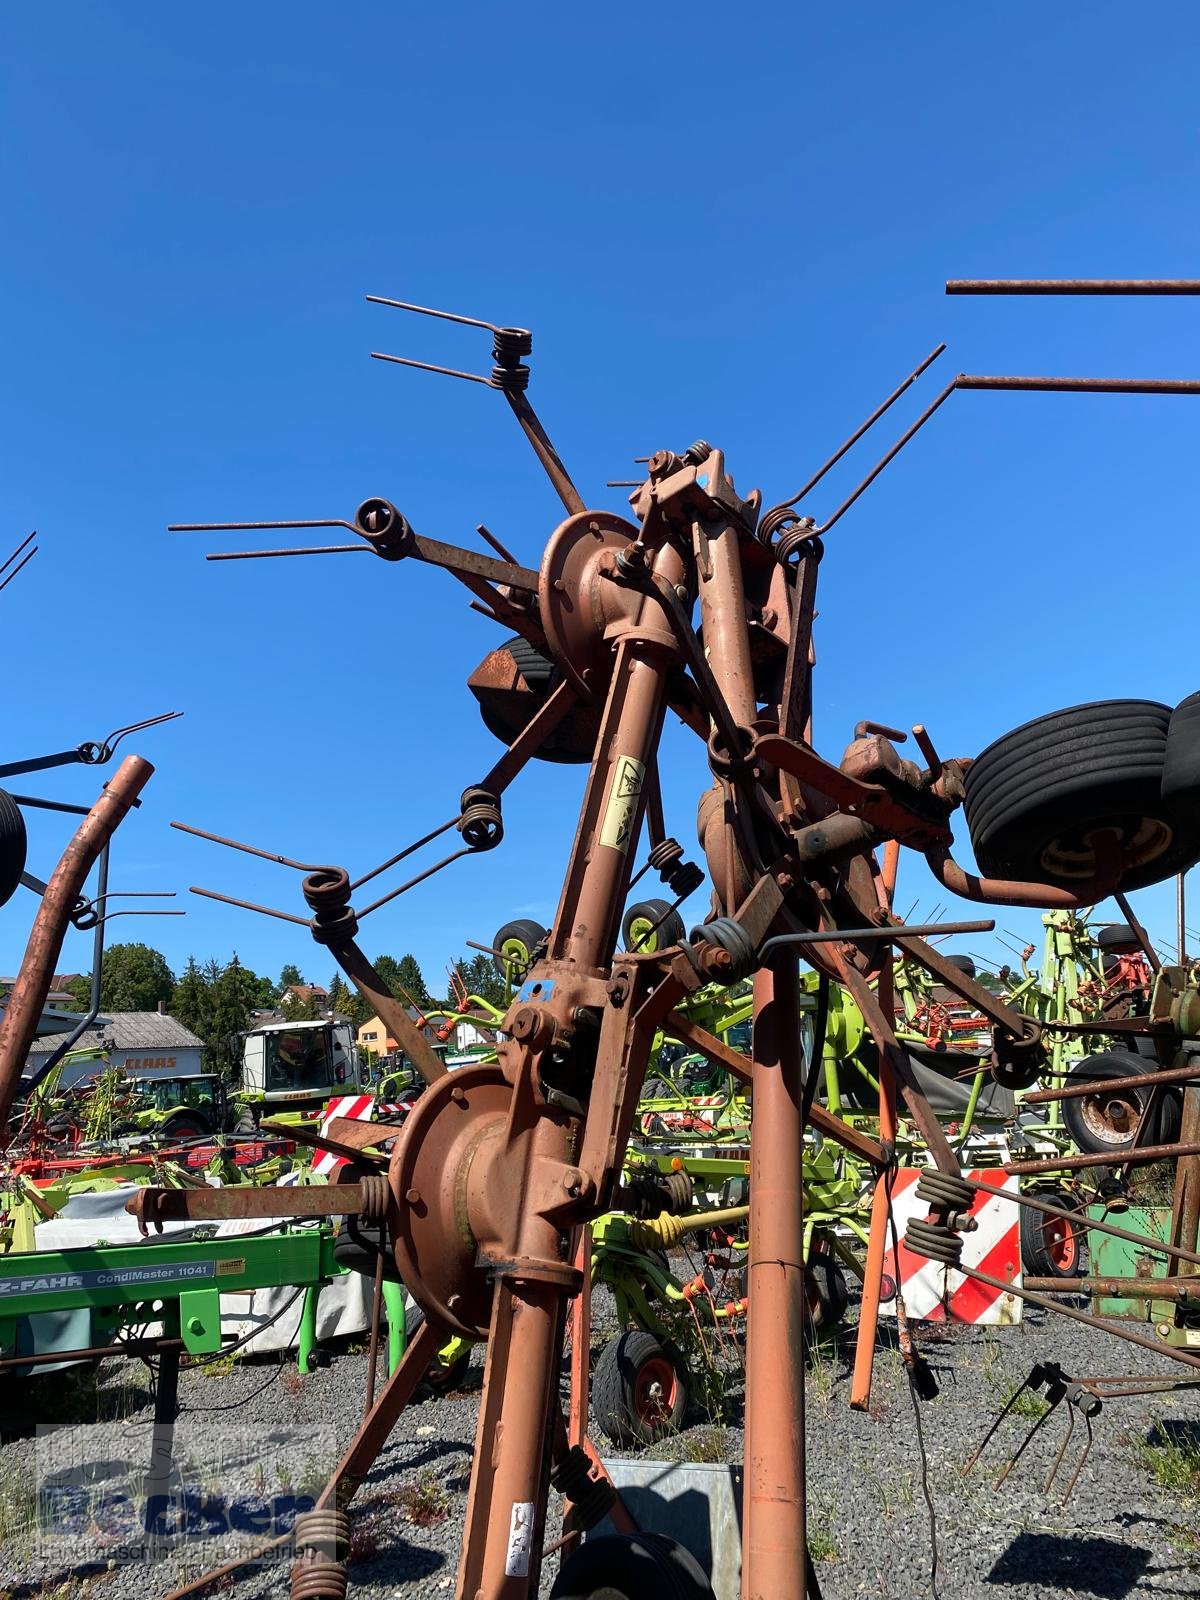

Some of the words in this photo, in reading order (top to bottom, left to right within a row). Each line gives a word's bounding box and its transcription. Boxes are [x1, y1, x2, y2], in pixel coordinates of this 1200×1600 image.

[126, 1057, 176, 1070] CLAAS
[284, 1092, 312, 1100] CLAAS
[97, 1269, 174, 1284] CondiMaster
[178, 1266, 207, 1276] 11041
